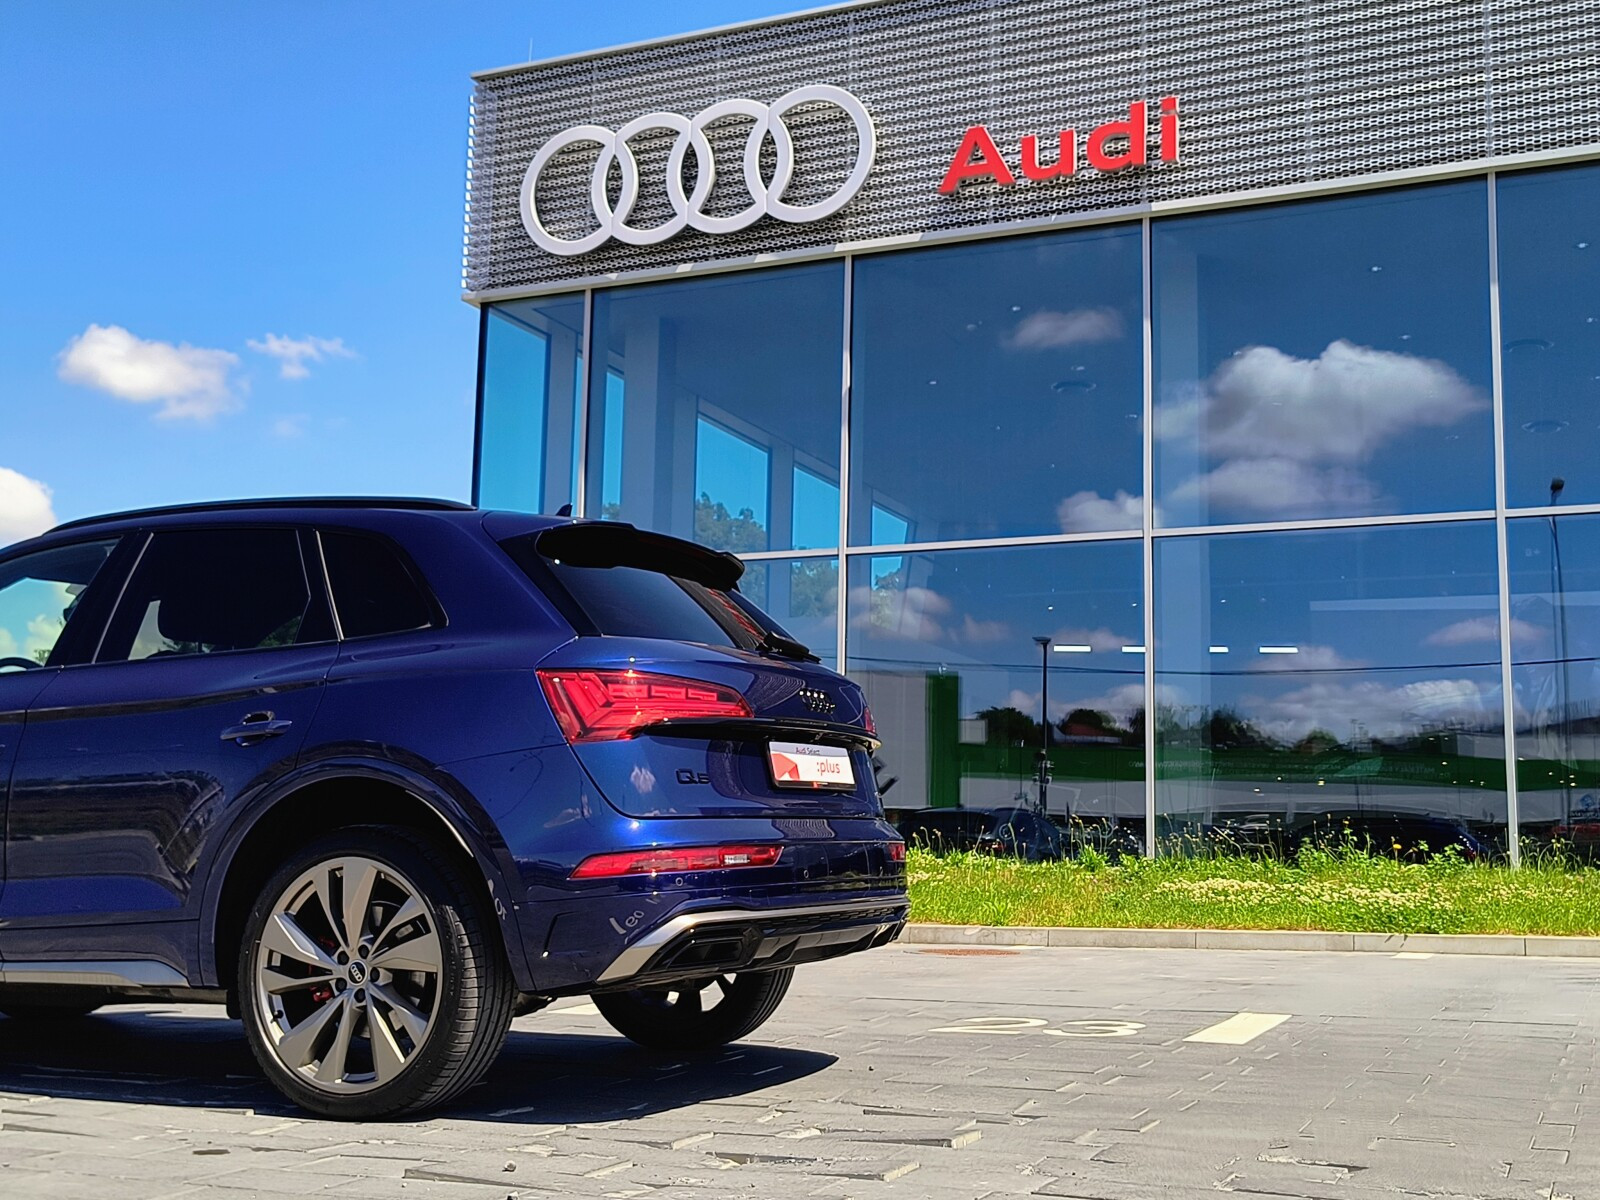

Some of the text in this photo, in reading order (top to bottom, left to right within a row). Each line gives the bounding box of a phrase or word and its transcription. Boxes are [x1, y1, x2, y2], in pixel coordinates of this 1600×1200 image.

[937, 96, 1181, 195] Audi
[675, 768, 711, 785] Q5
[927, 1016, 1147, 1037] 23
